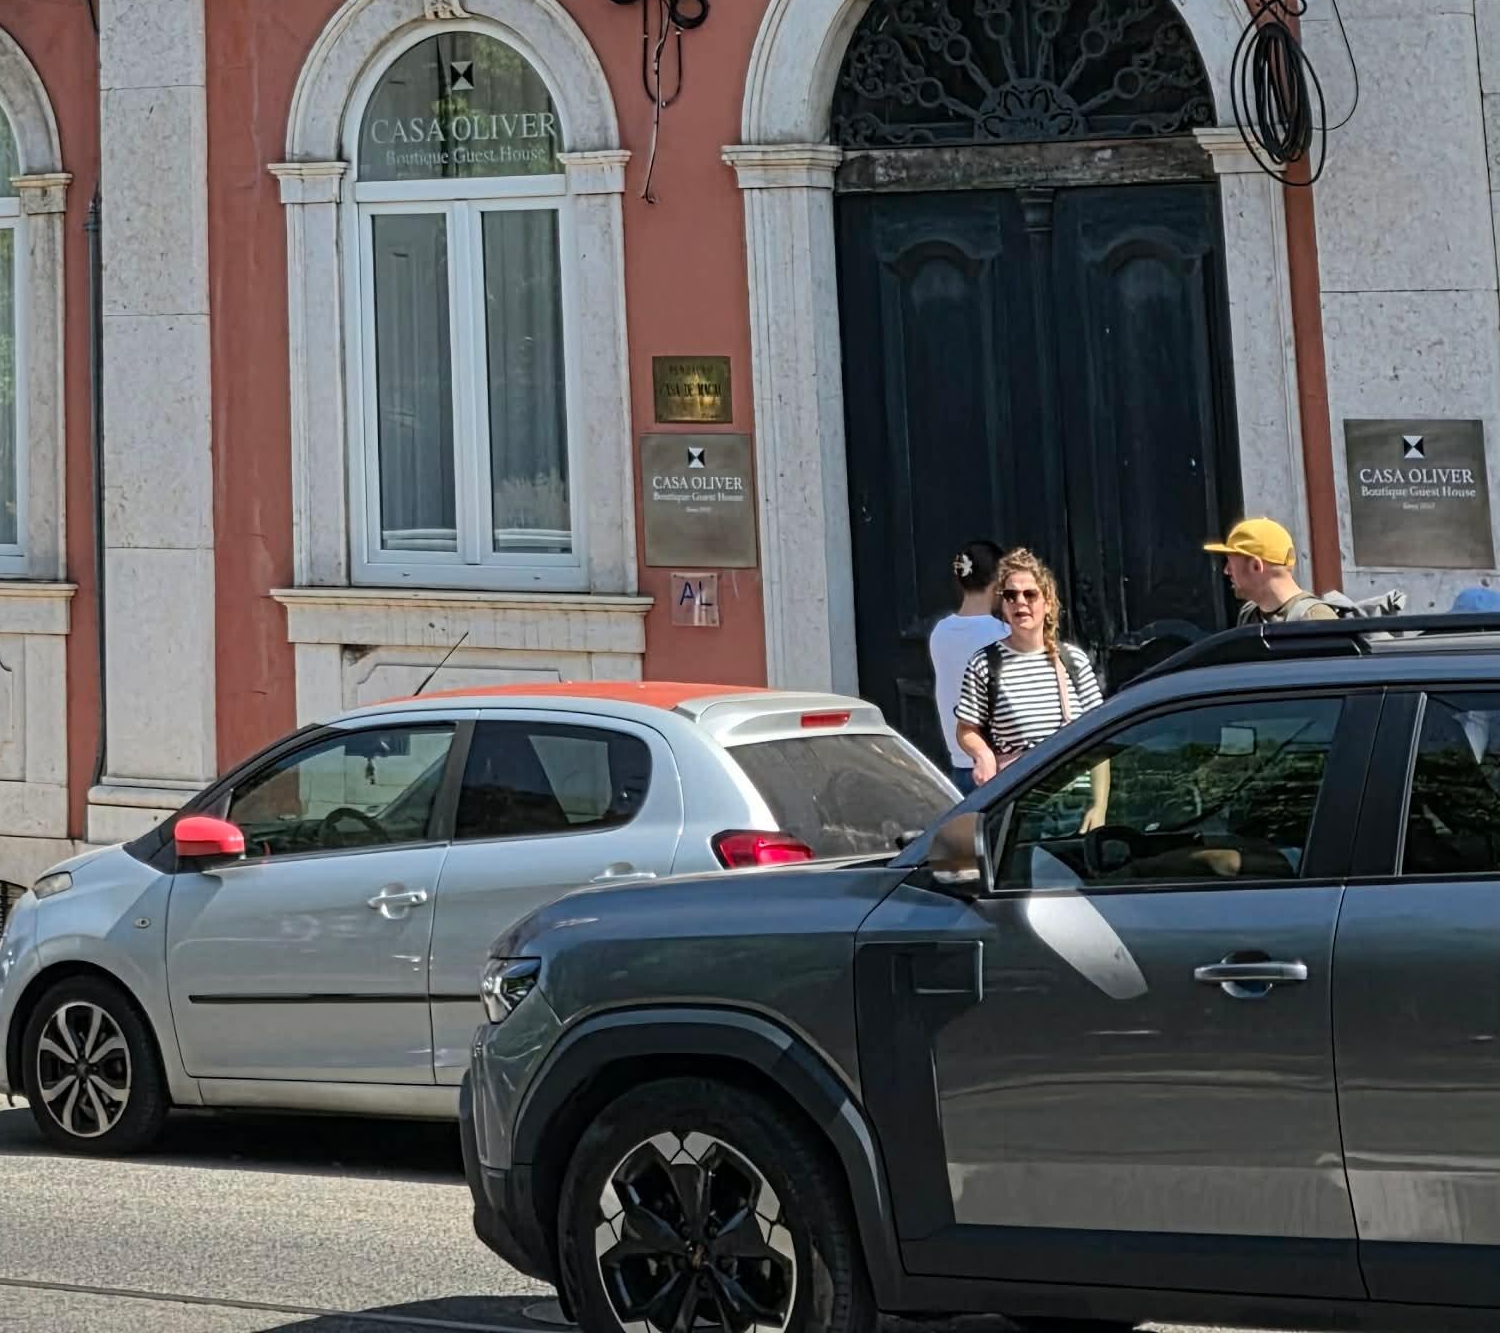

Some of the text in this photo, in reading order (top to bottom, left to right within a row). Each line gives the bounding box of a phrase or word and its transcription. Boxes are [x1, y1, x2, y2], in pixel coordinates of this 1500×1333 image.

[371, 112, 557, 144] CASA OLIVER
[454, 147, 495, 164] Guest
[500, 146, 548, 163] House
[652, 476, 743, 490] CASA OLIVER
[1360, 468, 1474, 483] CASA OLIVER
[1409, 486, 1440, 497] Guest
[1442, 486, 1476, 497] House
[679, 581, 713, 606] AL
